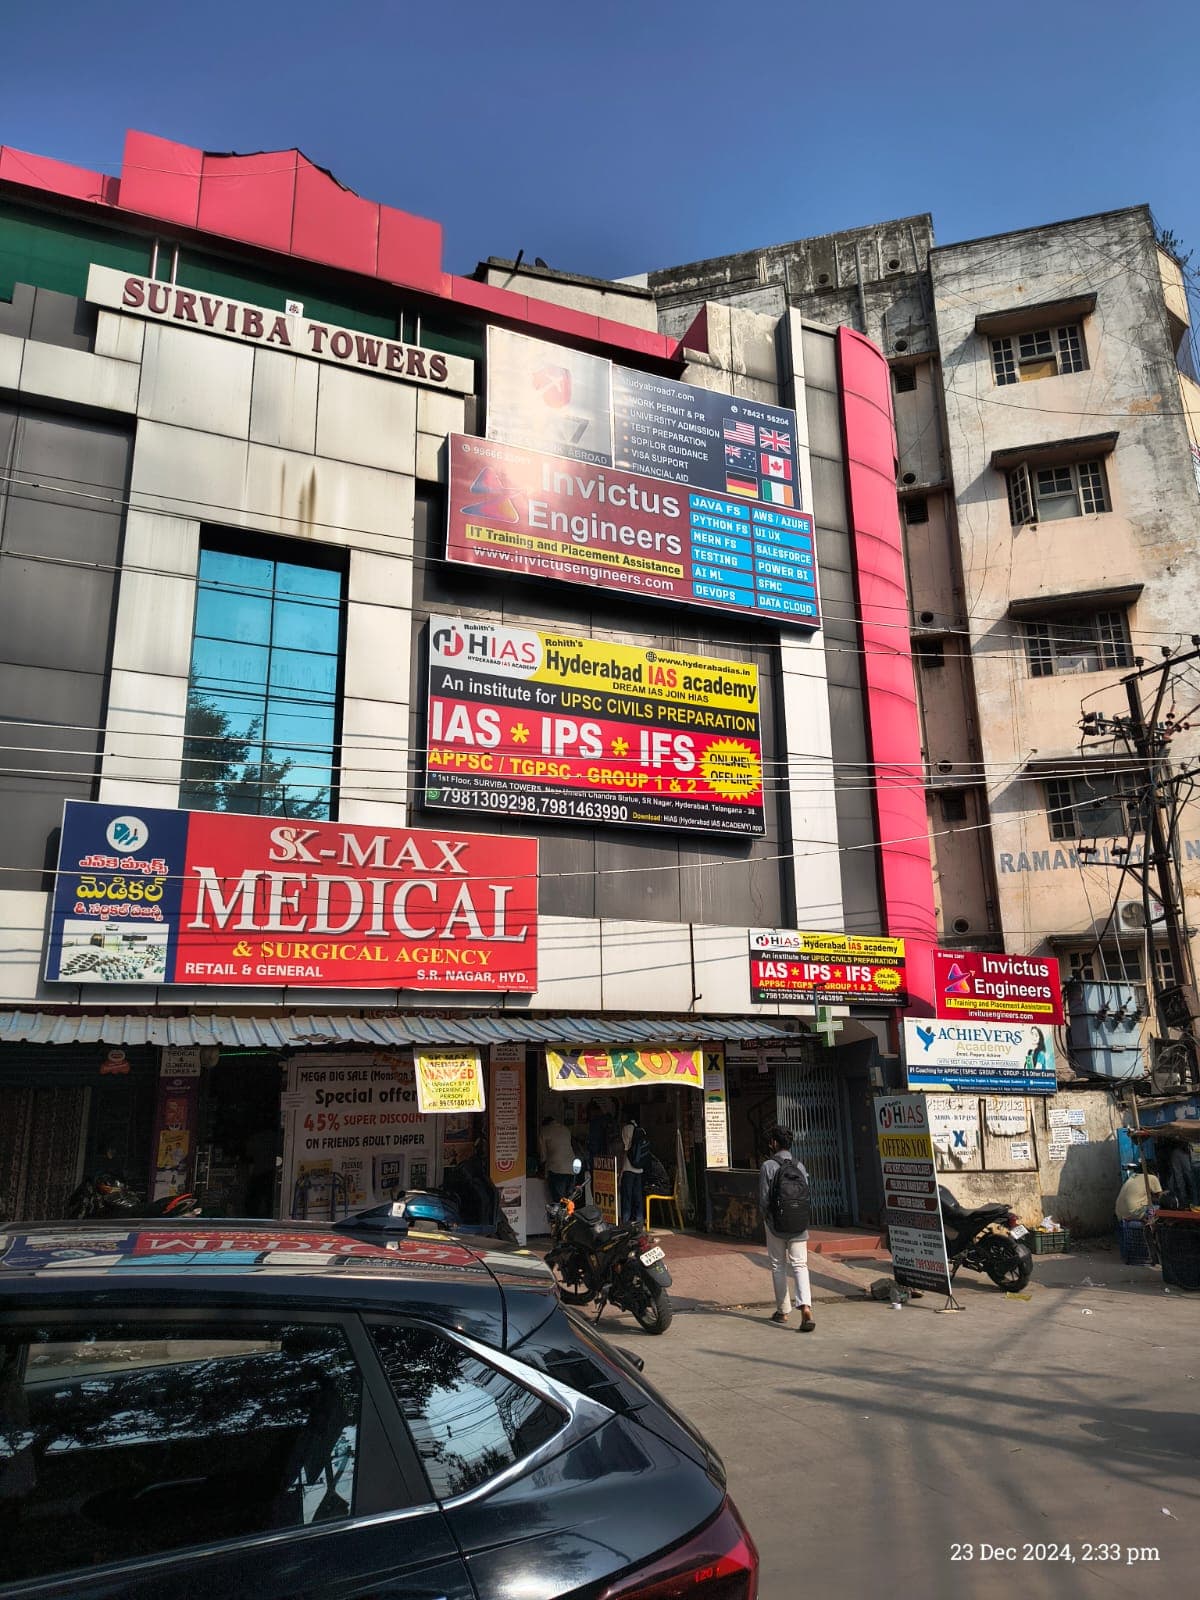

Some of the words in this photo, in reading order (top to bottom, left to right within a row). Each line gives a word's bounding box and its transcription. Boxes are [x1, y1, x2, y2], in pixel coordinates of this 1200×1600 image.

[122, 277, 291, 346] SURVIBA
[307, 323, 448, 382] TOWERS
[631, 397, 655, 410] WORK
[656, 402, 685, 417] PERMIT
[686, 410, 693, 419] &
[694, 412, 706, 422] PR
[630, 409, 676, 427] UNIVERSITY
[677, 421, 720, 438] ADMISSION
[631, 422, 650, 434] TEST
[652, 427, 707, 447] PREPARATION
[632, 448, 650, 461] VISA
[651, 454, 689, 470] SUPPORT
[668, 445, 709, 461] GUIDANCE
[632, 462, 674, 480] FINANCIAL
[675, 471, 689, 482] AID
[541, 462, 681, 518] Invictus
[693, 497, 723, 513] JAVA
[726, 505, 741, 516] FS
[527, 499, 683, 555] Engineers
[693, 514, 733, 531] PYTHON
[735, 523, 748, 535] FS
[754, 511, 773, 523] AWS
[781, 517, 809, 531] AZURE
[694, 532, 722, 545] MERN
[725, 538, 737, 549] FS
[755, 528, 766, 538] UI
[768, 531, 781, 541] UX
[469, 525, 483, 539] IT
[485, 528, 534, 550] Training
[537, 538, 558, 552] and
[561, 543, 621, 564] Placement
[622, 554, 681, 576] Assistance
[694, 549, 738, 566] TESTING
[756, 544, 811, 564] SALESFORCE
[473, 545, 674, 591] www.invictusengineers.com
[695, 567, 707, 578] AI
[709, 569, 724, 581] ML
[758, 561, 794, 577] POWER
[796, 569, 809, 580] BI
[696, 584, 736, 600] DEVOPS
[758, 579, 783, 591] SFMC
[759, 596, 782, 609] DATA
[783, 601, 812, 614] CLOUD
[464, 623, 495, 632] Rohith's
[469, 633, 536, 664] HIAS
[545, 638, 584, 648] Rohith's
[657, 655, 751, 677] www.hyderabadias.in
[546, 649, 643, 683] Hyderabad
[648, 665, 678, 688] IAS
[682, 675, 757, 704] academy
[441, 673, 464, 692] An
[469, 677, 531, 701] institute
[535, 687, 557, 705] for
[560, 691, 603, 712] UPSC
[606, 698, 654, 719] CIVILS
[657, 705, 756, 732] PREPARATION
[612, 681, 646, 695] DREAM
[648, 687, 663, 697] IAS
[665, 690, 686, 700] JOIN
[688, 693, 709, 704] HIAS
[431, 701, 502, 749] IAS
[541, 716, 604, 760] IPS
[640, 730, 696, 772] IFS
[428, 747, 494, 772] APPSC
[509, 757, 572, 780] TGPSC
[587, 767, 649, 789] GROUP
[653, 775, 663, 790] 1
[669, 778, 682, 793] &
[687, 779, 697, 794] 2
[710, 770, 753, 786] OFFLINE
[438, 773, 450, 782] 1st
[451, 776, 472, 786] Floor,
[473, 778, 507, 789] SURVIBA
[711, 804, 743, 815] Telangana
[441, 786, 628, 821] 7981309298,7981463990
[268, 826, 469, 874] SK-MAX
[187, 866, 530, 944] MEDICAL
[771, 935, 800, 946] HIAS
[804, 940, 847, 950] Hyderabad
[848, 943, 862, 951] IAS
[863, 944, 898, 954] academy
[232, 940, 253, 958] &
[259, 942, 390, 963] SURGICAL
[394, 947, 493, 966] AGENCY
[811, 954, 830, 962] UPSC
[853, 957, 898, 965] PREPARATION
[184, 962, 238, 977] RETAIL
[242, 964, 252, 976] &
[255, 964, 324, 978] GENERAL
[416, 968, 442, 981] S.R.
[445, 969, 496, 984] NAGAR,
[499, 971, 530, 984] HYD.
[758, 961, 788, 979] IAS
[803, 964, 831, 981] IPS
[846, 965, 872, 982] IFS
[982, 956, 1049, 977] Invictus
[759, 979, 786, 988] APPSC
[824, 982, 851, 990] GROUP
[974, 979, 1052, 999] Engineers
[954, 998, 978, 1008] Training
[990, 1001, 1020, 1010] Placement
[938, 1026, 1023, 1046] ACHIEVERS
[956, 1041, 1012, 1055] Academy
[553, 1048, 699, 1080] XEROX
[301, 1070, 327, 1082] MEGA
[329, 1070, 345, 1082] BIG
[347, 1070, 368, 1082] SALE
[315, 1087, 372, 1107] Special
[303, 1112, 340, 1132] 45%
[344, 1113, 376, 1126] SUPER
[379, 1112, 427, 1125] DISCOUNT
[893, 1105, 924, 1124] HIAS
[306, 1137, 319, 1149] ON
[322, 1136, 360, 1149] FRIENDS
[362, 1134, 390, 1146] ADULT
[393, 1133, 425, 1146] DIAPER
[881, 1138, 911, 1158] OFFERS
[911, 1138, 929, 1158] YOU
[595, 1191, 615, 1207] DTP
